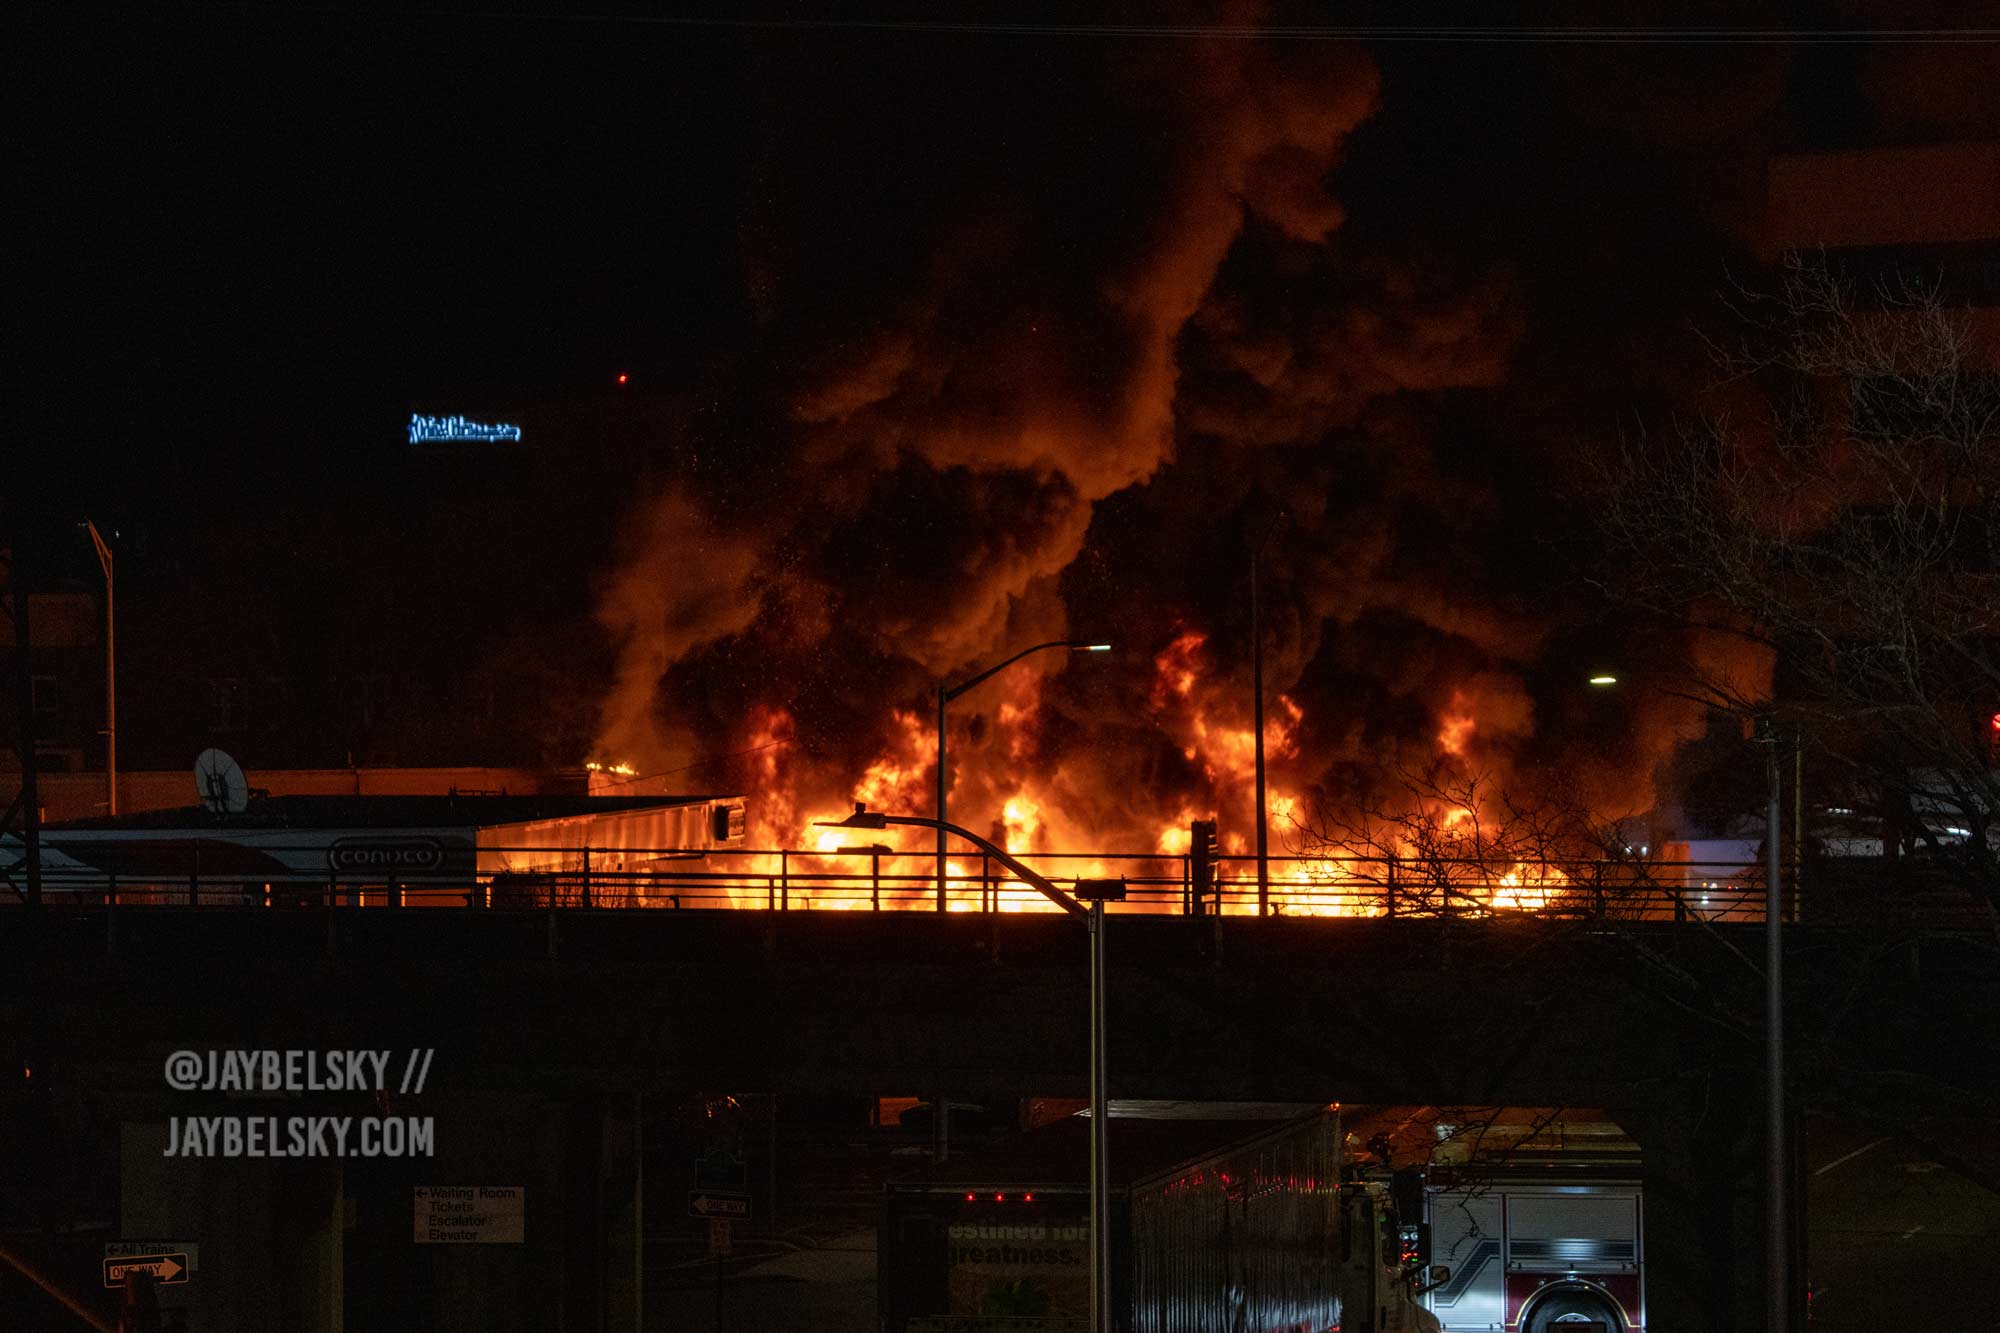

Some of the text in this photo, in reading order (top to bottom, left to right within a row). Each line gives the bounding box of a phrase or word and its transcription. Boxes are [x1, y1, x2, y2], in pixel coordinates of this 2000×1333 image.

[430, 1188, 516, 1201] Waiting Room
[429, 1201, 474, 1213] Tickets
[706, 1200, 744, 1211] ONE WAY
[429, 1215, 485, 1227] Escalator
[429, 1228, 479, 1241] Elevator
[949, 1219, 1046, 1241] estined
[121, 1243, 176, 1254] All Trains
